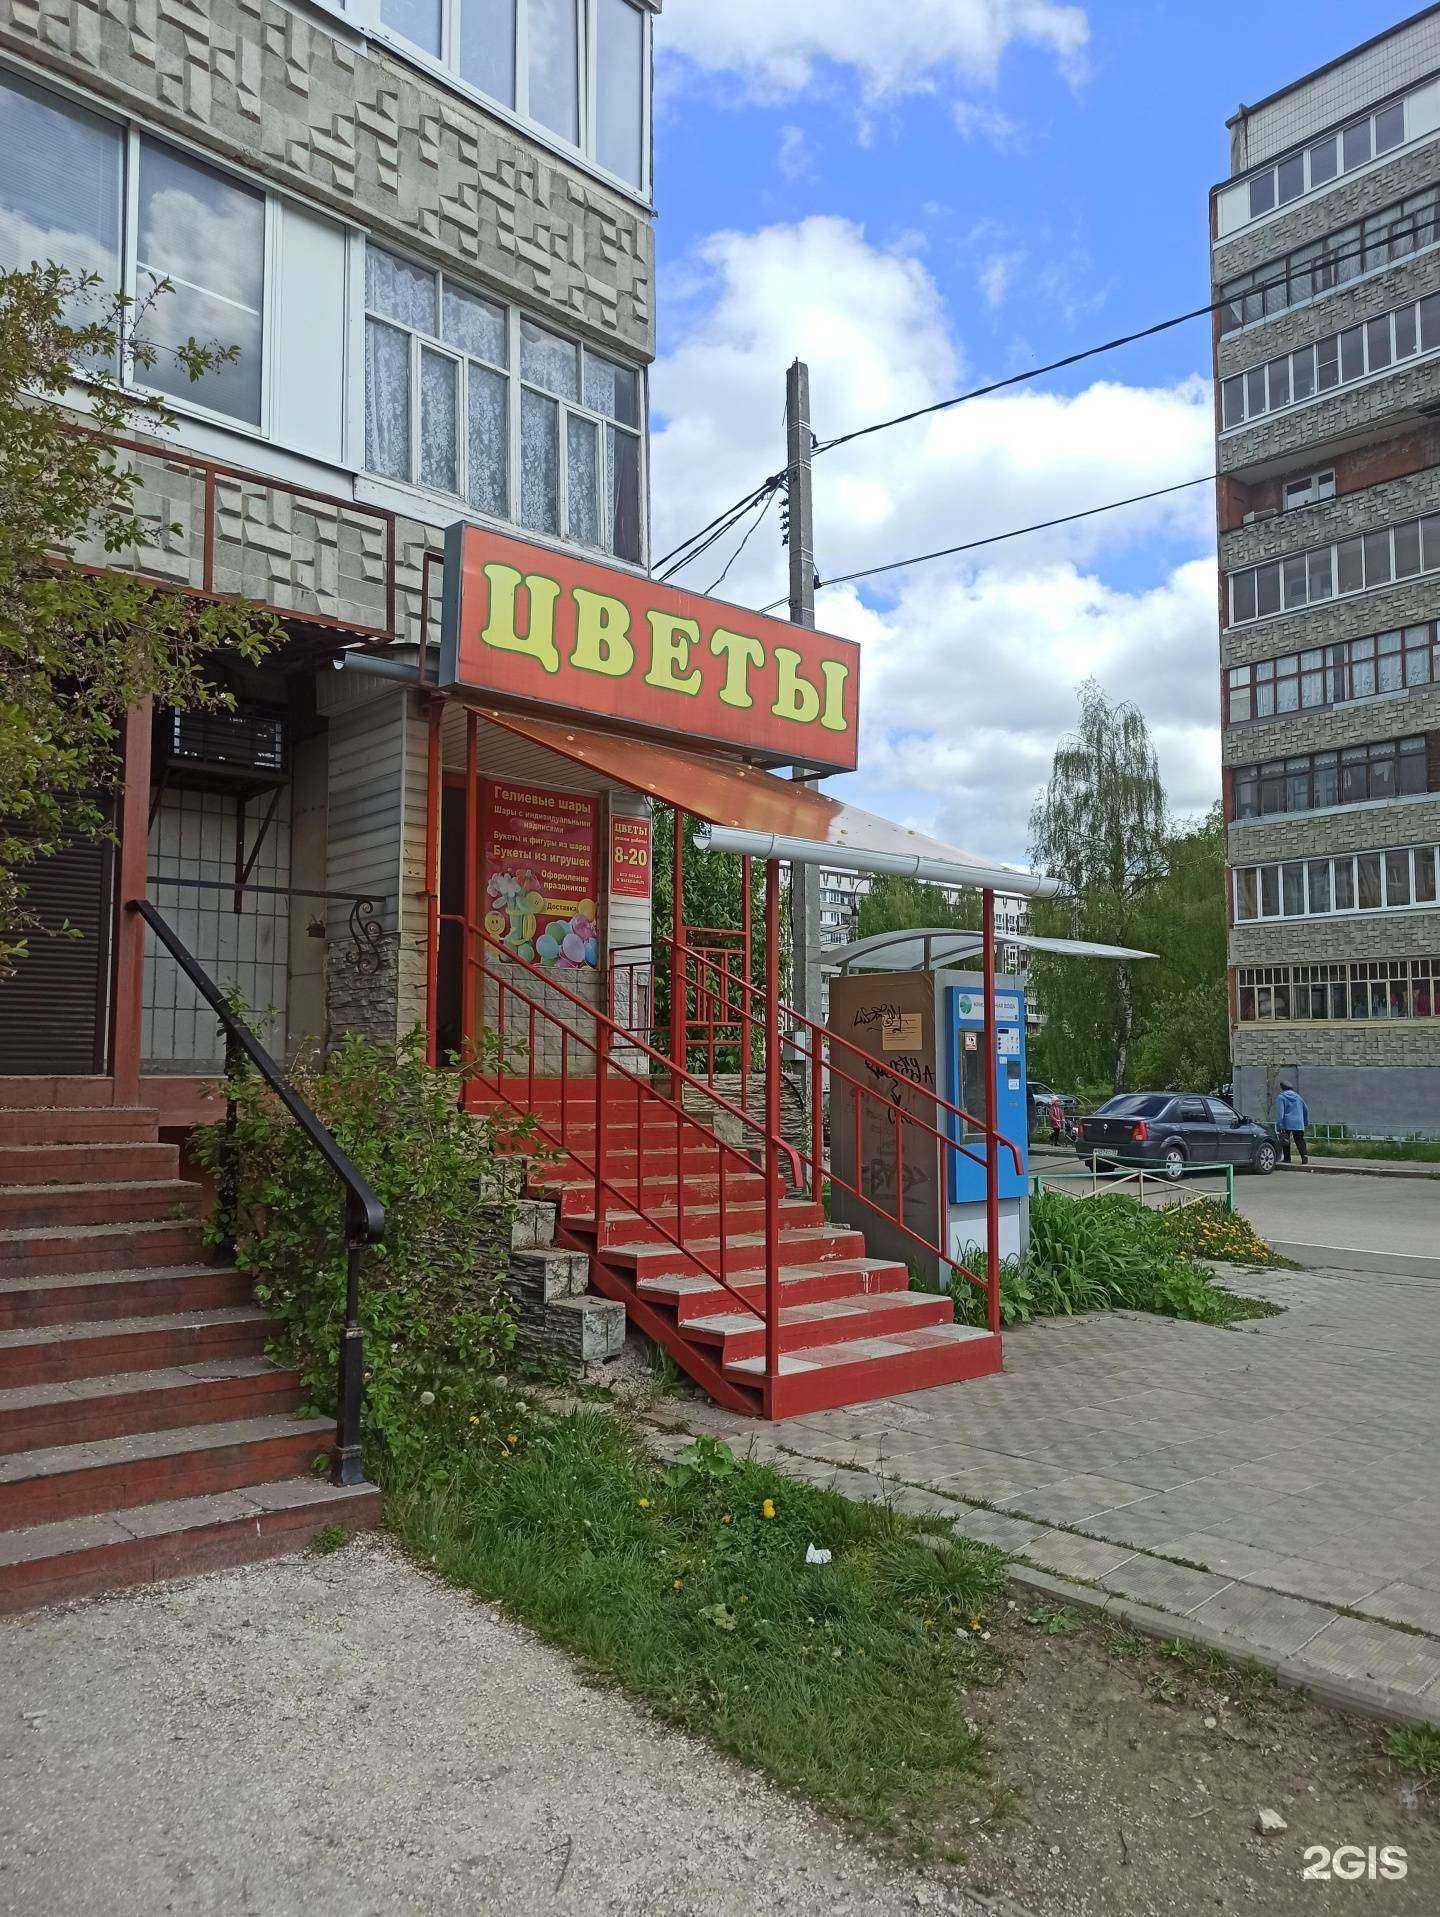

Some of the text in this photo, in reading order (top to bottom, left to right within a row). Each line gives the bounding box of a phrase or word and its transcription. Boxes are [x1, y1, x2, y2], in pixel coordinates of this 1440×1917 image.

[481, 562, 850, 732] ЦВЕТЫ
[494, 786, 591, 815] Гелиевые шары
[494, 805, 517, 816] Шары
[614, 823, 648, 836] ЦВЕТЫ
[493, 830, 521, 842] Букеты
[529, 835, 557, 848] фигуры
[493, 844, 590, 868] Букеты из игрушек
[614, 846, 648, 866] 8-20
[541, 869, 589, 883] Оформление
[543, 882, 587, 893] праздников
[546, 902, 577, 912] Доставка
